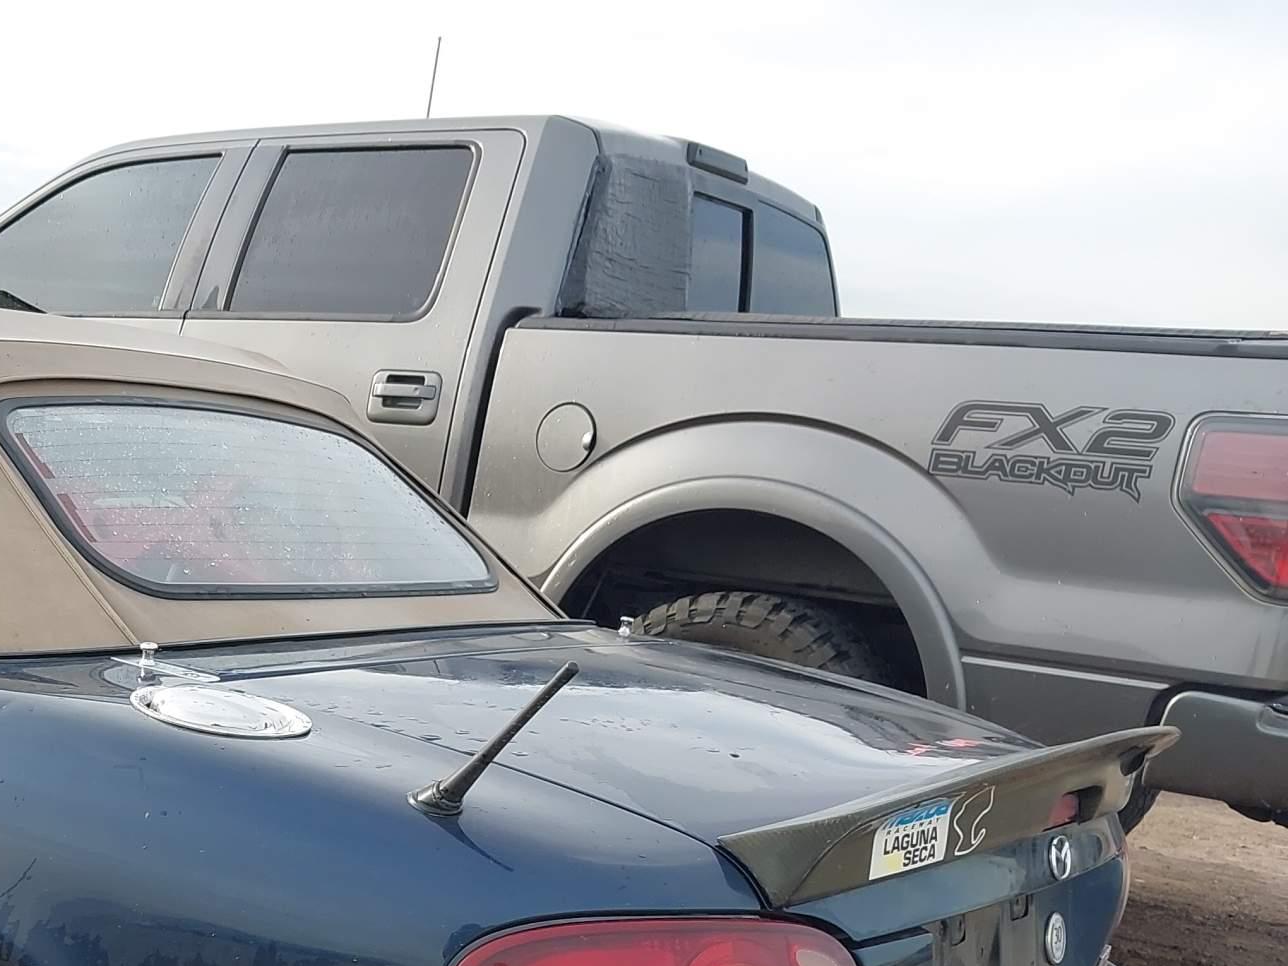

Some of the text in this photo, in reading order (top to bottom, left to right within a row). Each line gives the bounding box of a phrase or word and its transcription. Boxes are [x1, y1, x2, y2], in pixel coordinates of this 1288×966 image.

[931, 399, 1176, 461] FX2
[928, 448, 1153, 504] BLACKOUT
[883, 826, 938, 856] LAGUNA
[886, 817, 940, 836] RACEWAY
[902, 843, 937, 868] SECA
